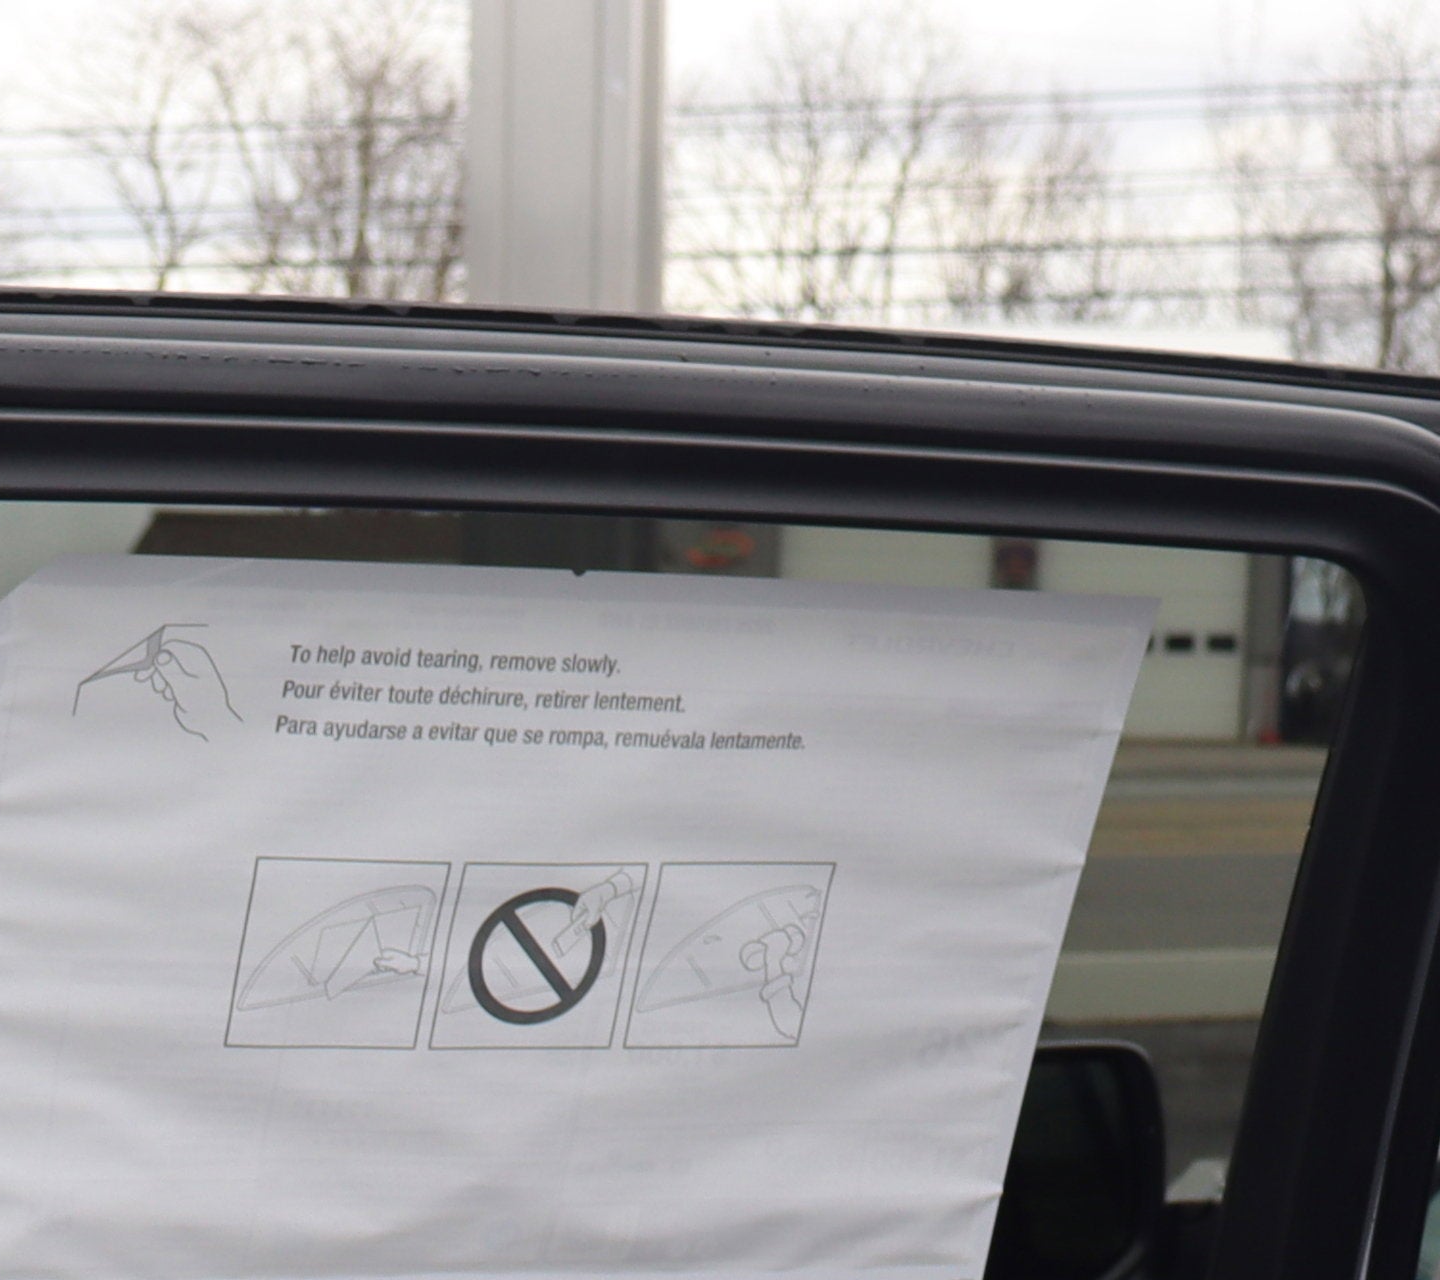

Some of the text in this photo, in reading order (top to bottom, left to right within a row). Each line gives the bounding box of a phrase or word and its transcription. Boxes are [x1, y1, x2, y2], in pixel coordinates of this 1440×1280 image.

[290, 644, 622, 678] To help avoid tearing, remove slowly.
[281, 679, 687, 713] Pour éviter toute déchirure, retirer lentement.
[274, 714, 806, 751] Para ayudarse a evitar que se rompa, remuévala lentamente.
